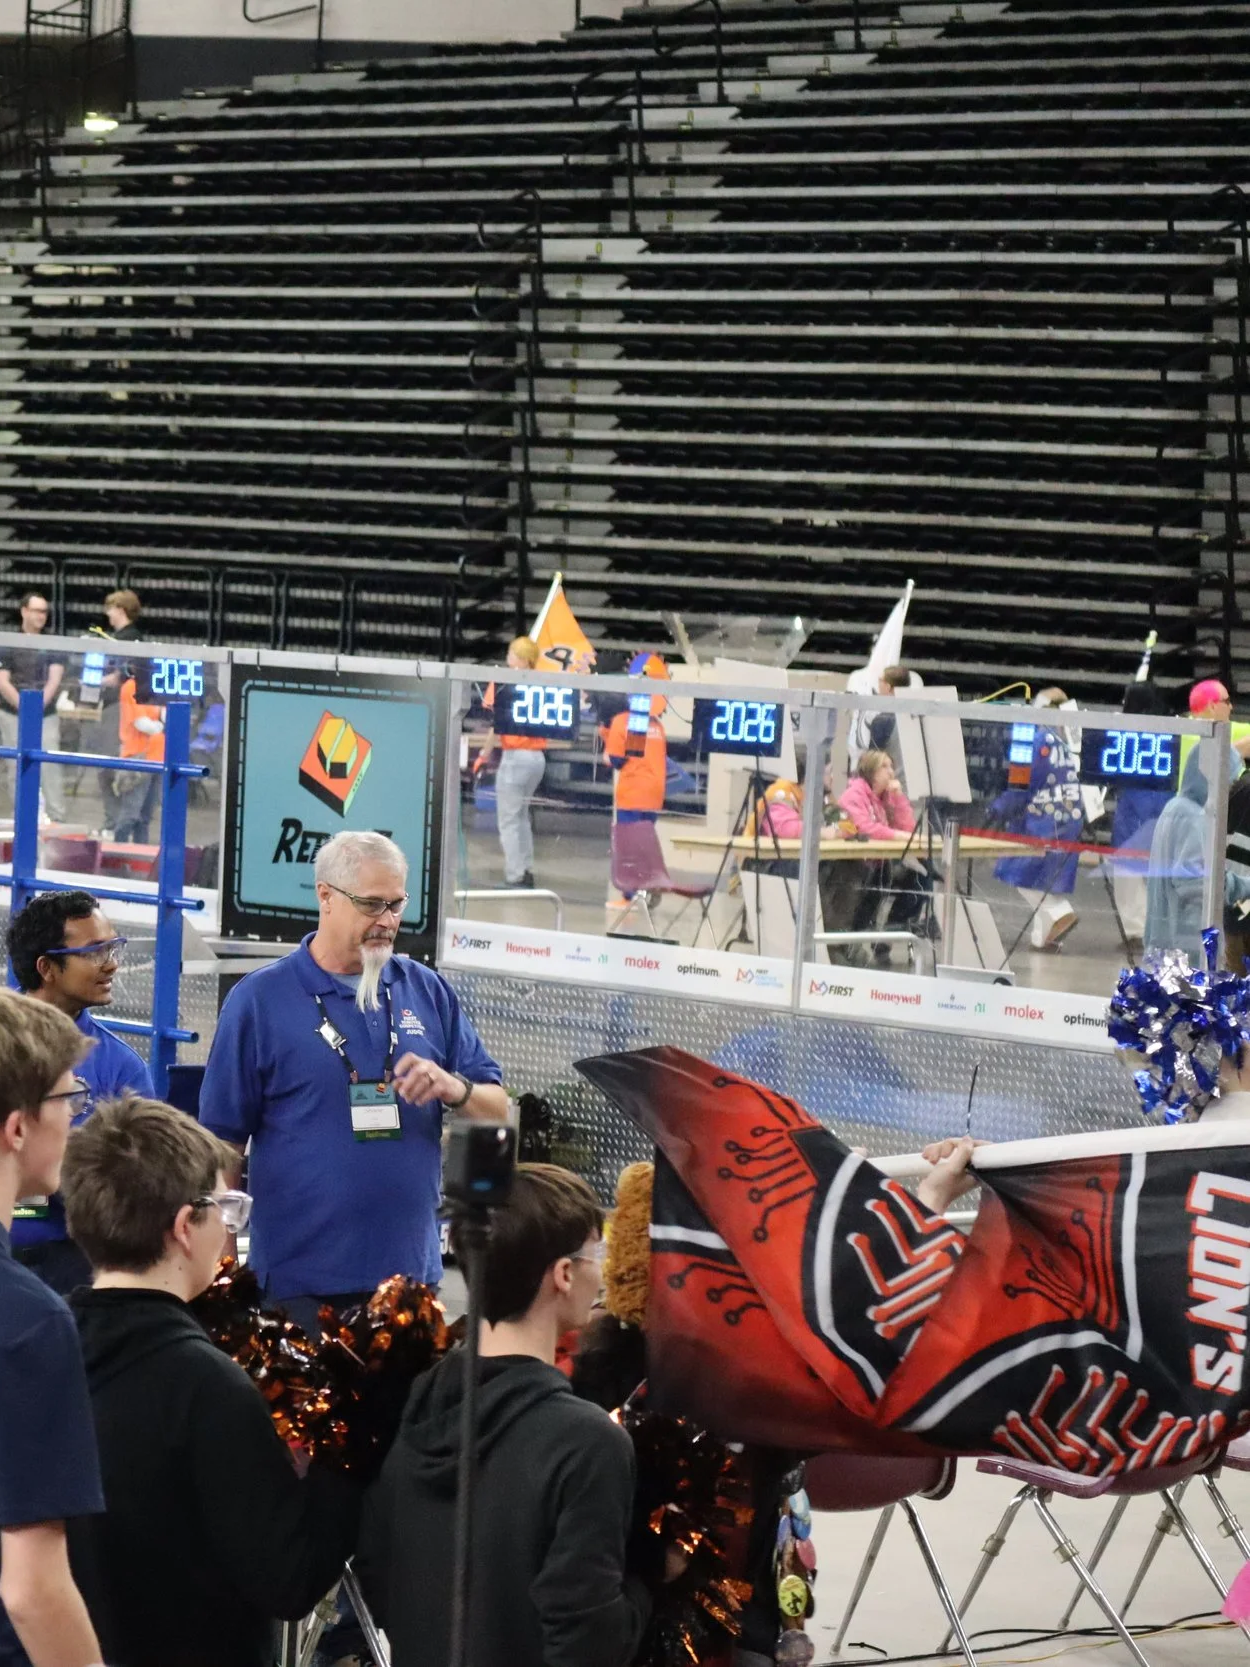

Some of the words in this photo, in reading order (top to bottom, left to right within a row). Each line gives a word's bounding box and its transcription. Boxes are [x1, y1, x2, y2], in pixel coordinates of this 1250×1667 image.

[151, 658, 203, 697] 2026
[512, 684, 574, 727] 2026
[712, 700, 776, 744] 2026
[1102, 730, 1173, 776] 2026
[468, 938, 492, 950] FIRST
[506, 941, 551, 958] Honeywell
[624, 956, 661, 970] molex
[828, 984, 855, 997] FIRST
[870, 988, 922, 1006] Honeywell
[1004, 1004, 1044, 1021] molex
[1185, 1171, 1250, 1396] LION'S
